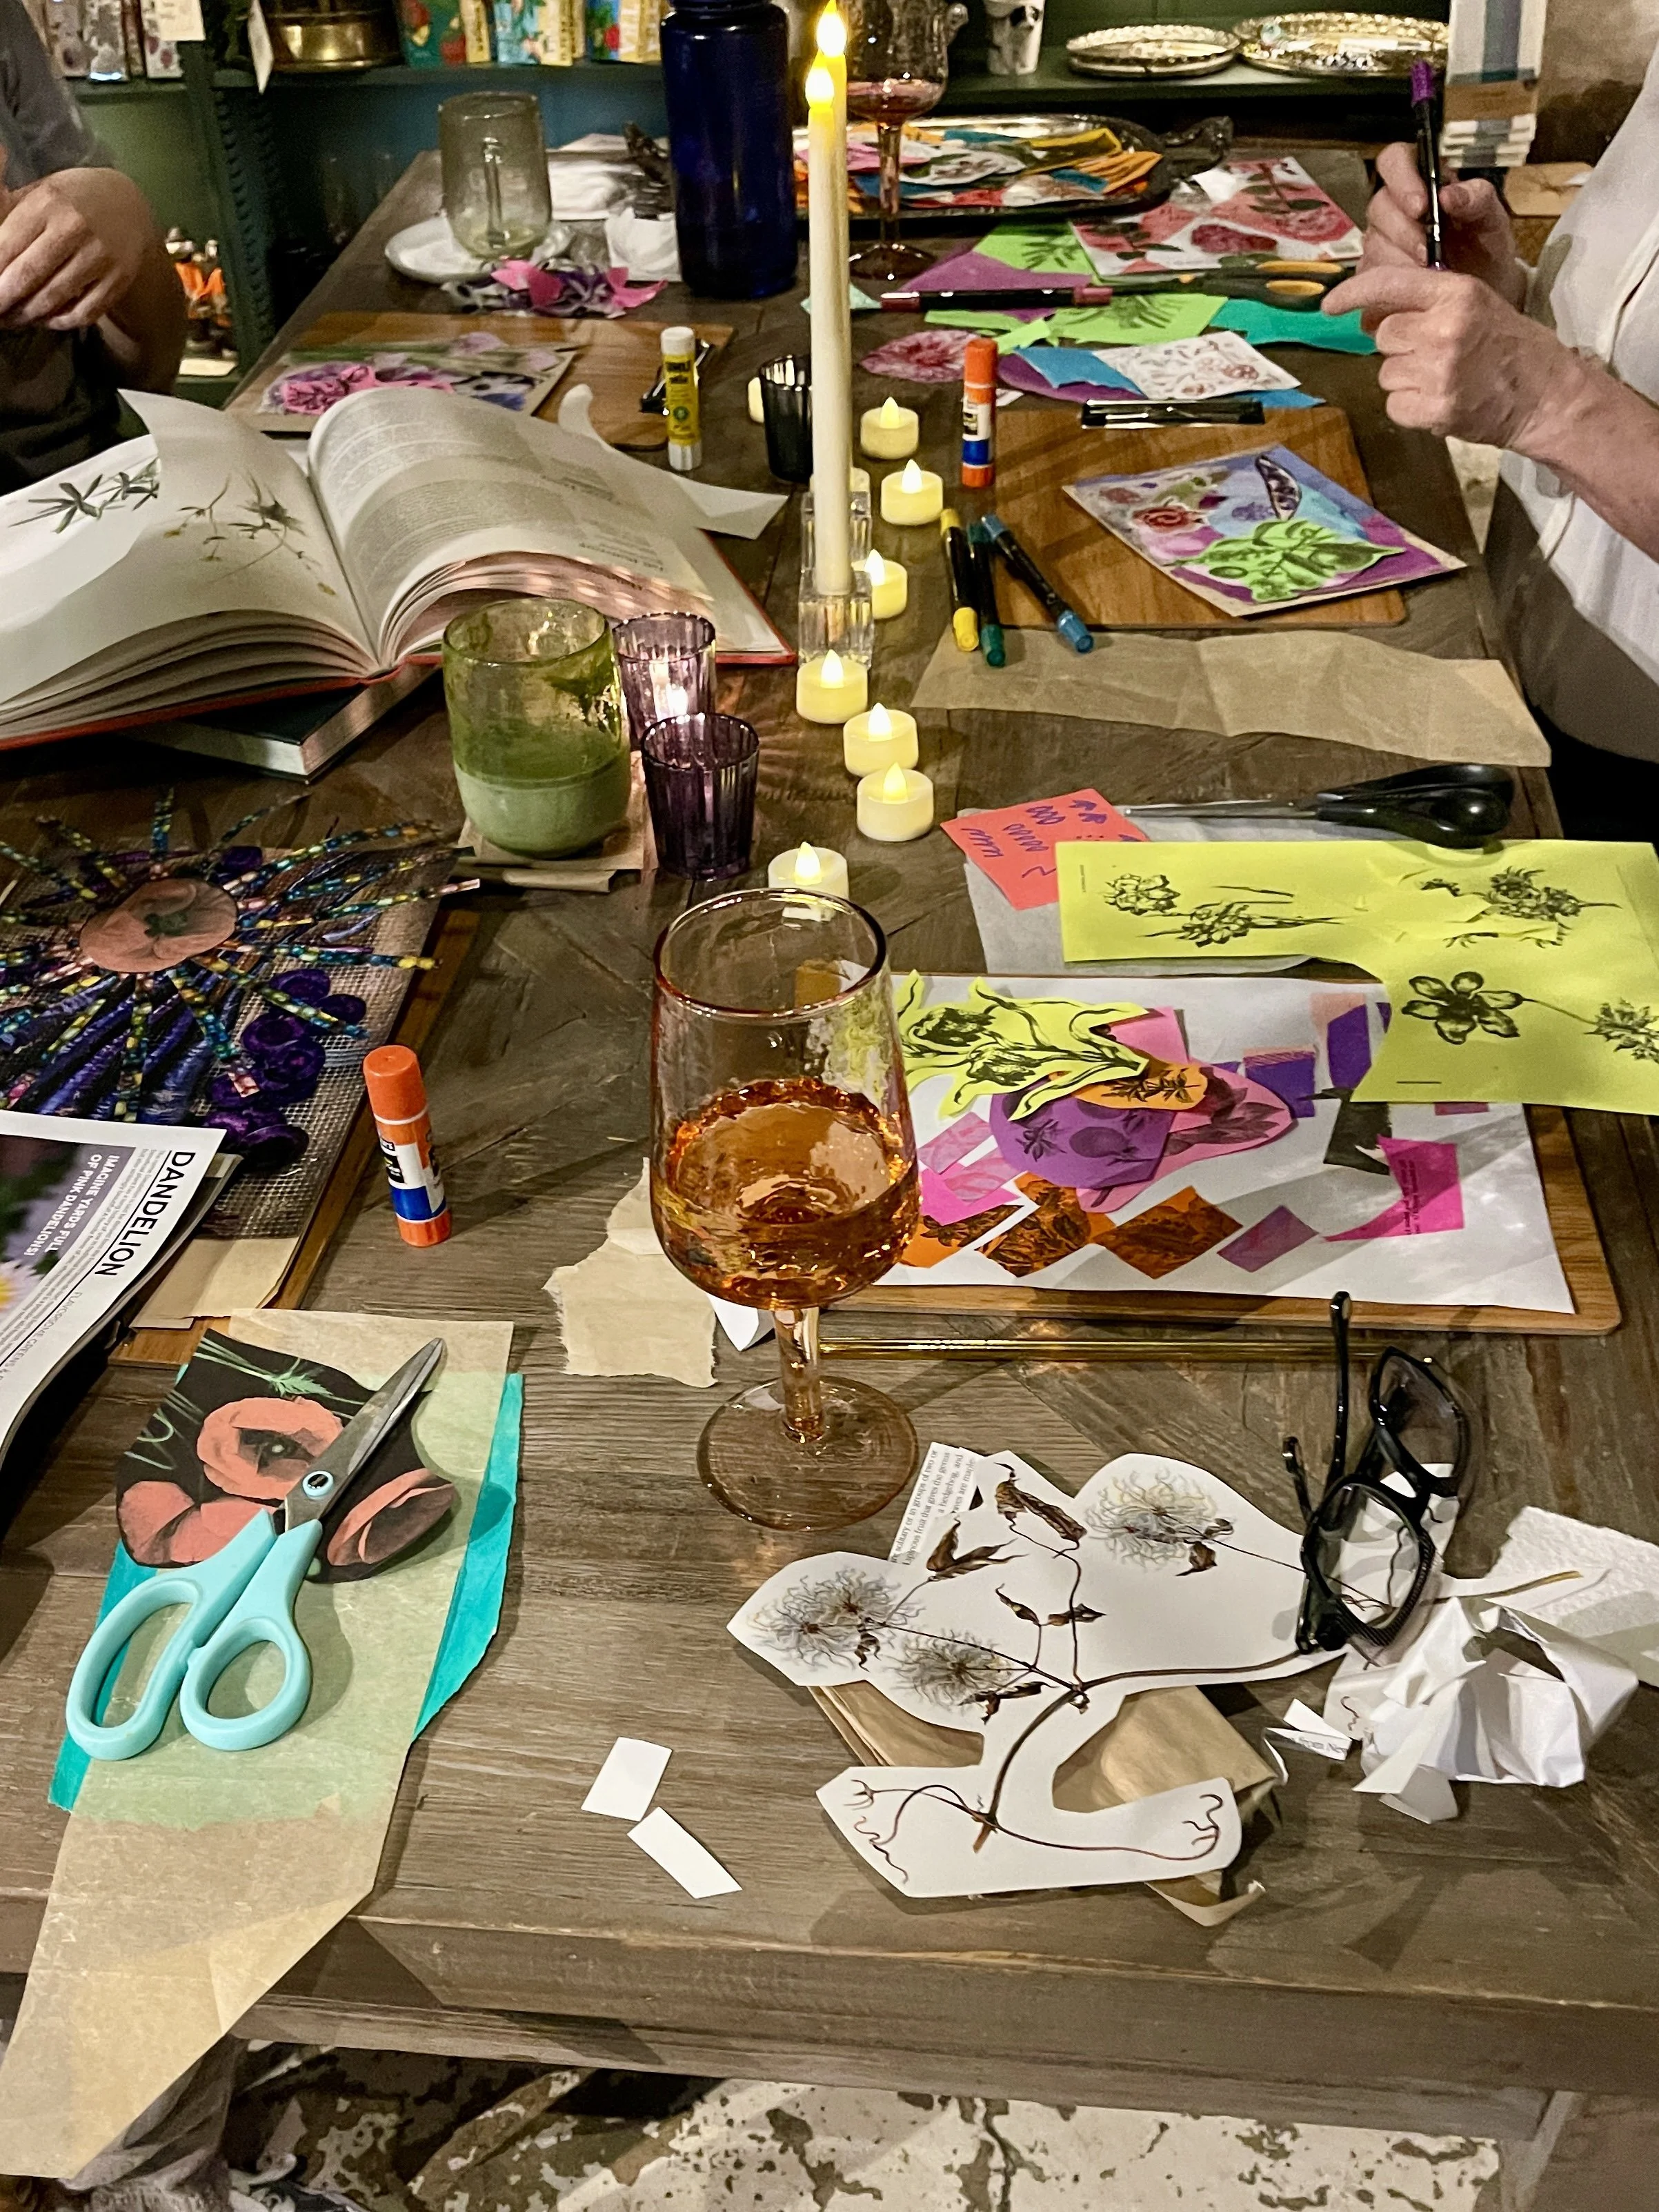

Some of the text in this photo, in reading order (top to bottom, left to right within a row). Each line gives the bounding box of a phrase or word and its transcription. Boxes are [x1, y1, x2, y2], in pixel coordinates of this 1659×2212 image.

[86, 1155, 120, 1196] IMAGINE
[24, 1154, 103, 1256] OF PINK DANDELIONS!
[63, 1197, 94, 1229] YARDS
[95, 1151, 197, 1276] DANDELION
[44, 1230, 70, 1253] FULL
[931, 1450, 937, 1458] or
[955, 1454, 964, 1468] and
[925, 1459, 933, 1473] two
[921, 1474, 930, 1483] of
[914, 1483, 928, 1508] groups
[915, 1519, 927, 1535] fruit
[921, 1504, 931, 1518] that
[928, 1486, 939, 1504] gives
[934, 1475, 942, 1486] the
[940, 1452, 950, 1474] genus
[906, 1517, 913, 1526] or
[909, 1508, 916, 1516] in
[895, 1527, 911, 1551] solitary
